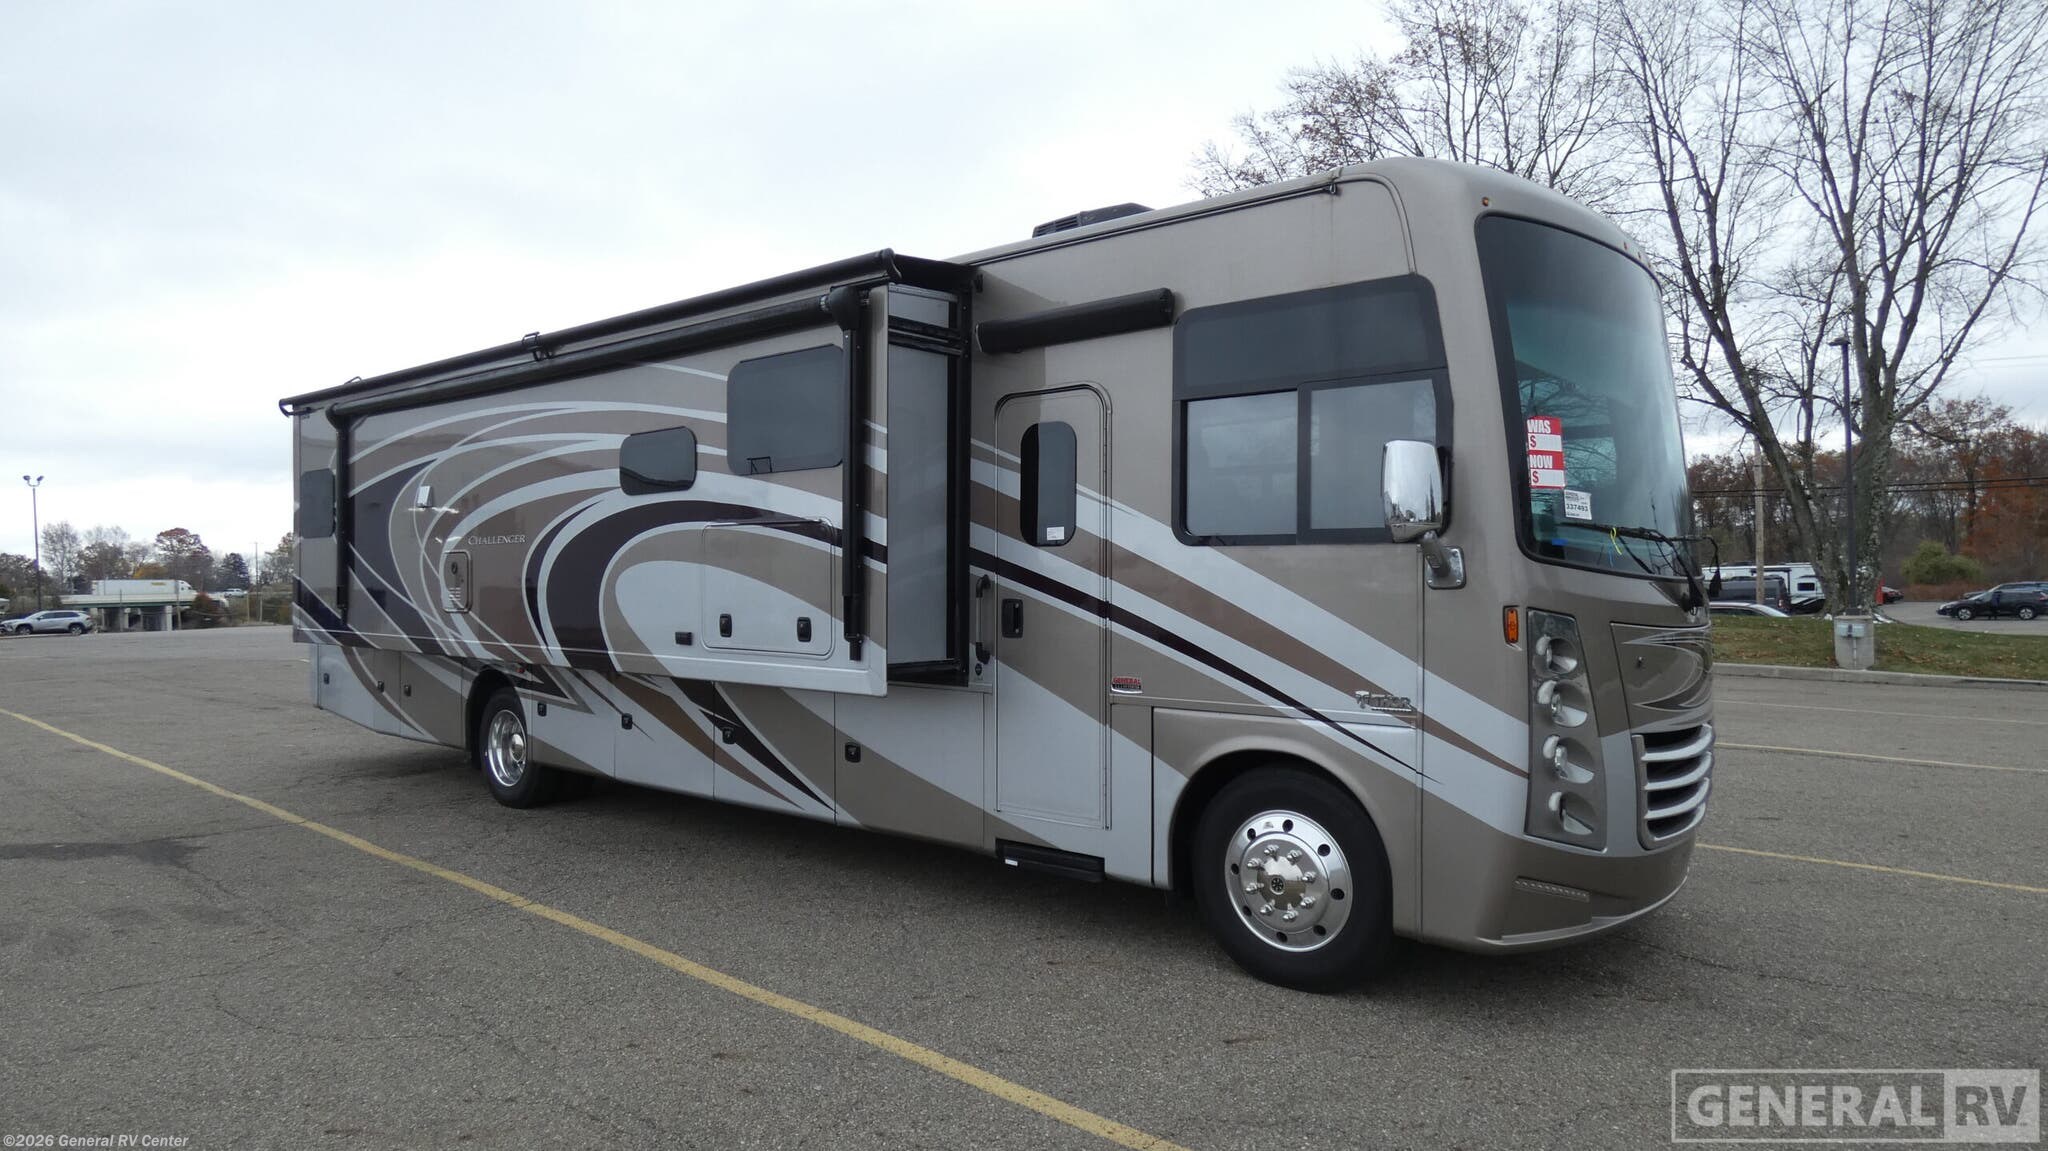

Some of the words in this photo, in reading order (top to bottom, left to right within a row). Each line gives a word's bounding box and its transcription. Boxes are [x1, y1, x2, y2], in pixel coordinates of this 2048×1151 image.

[1527, 419, 1551, 433] WAS
[1529, 455, 1553, 469] NOW
[468, 534, 526, 545] CHALLENGER
